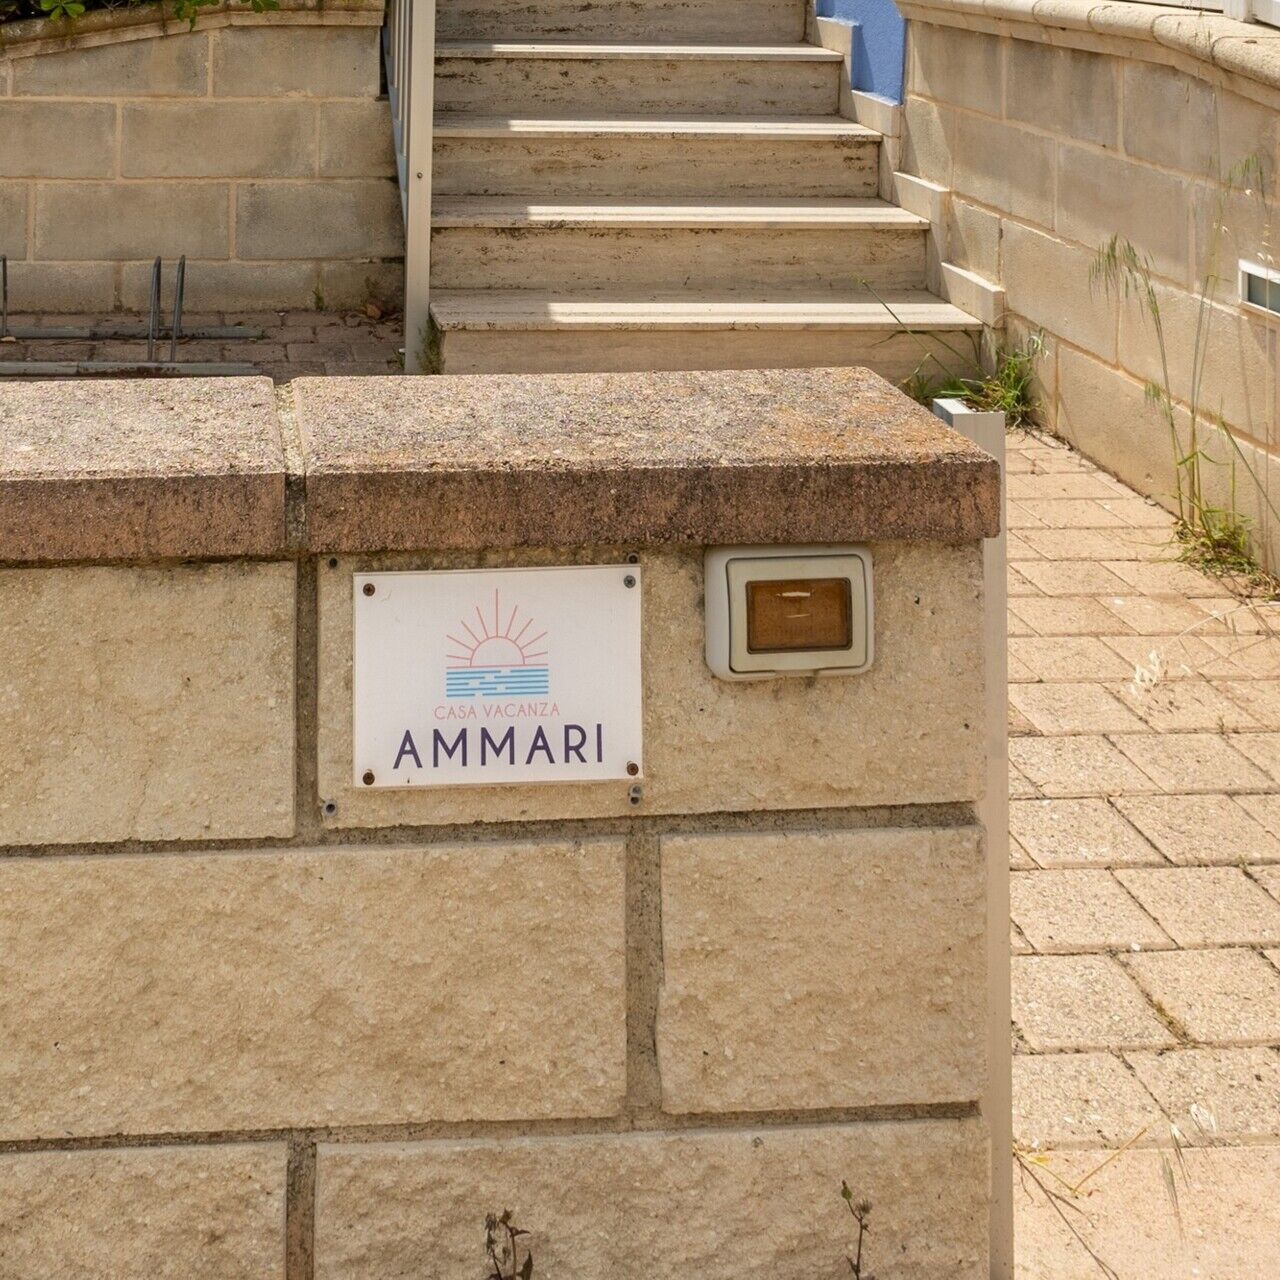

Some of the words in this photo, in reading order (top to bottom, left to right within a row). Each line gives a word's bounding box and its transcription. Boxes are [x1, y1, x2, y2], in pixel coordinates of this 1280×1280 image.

[433, 704, 477, 720] CASA
[483, 702, 560, 718] VACANZA
[392, 723, 603, 769] AMMARI
